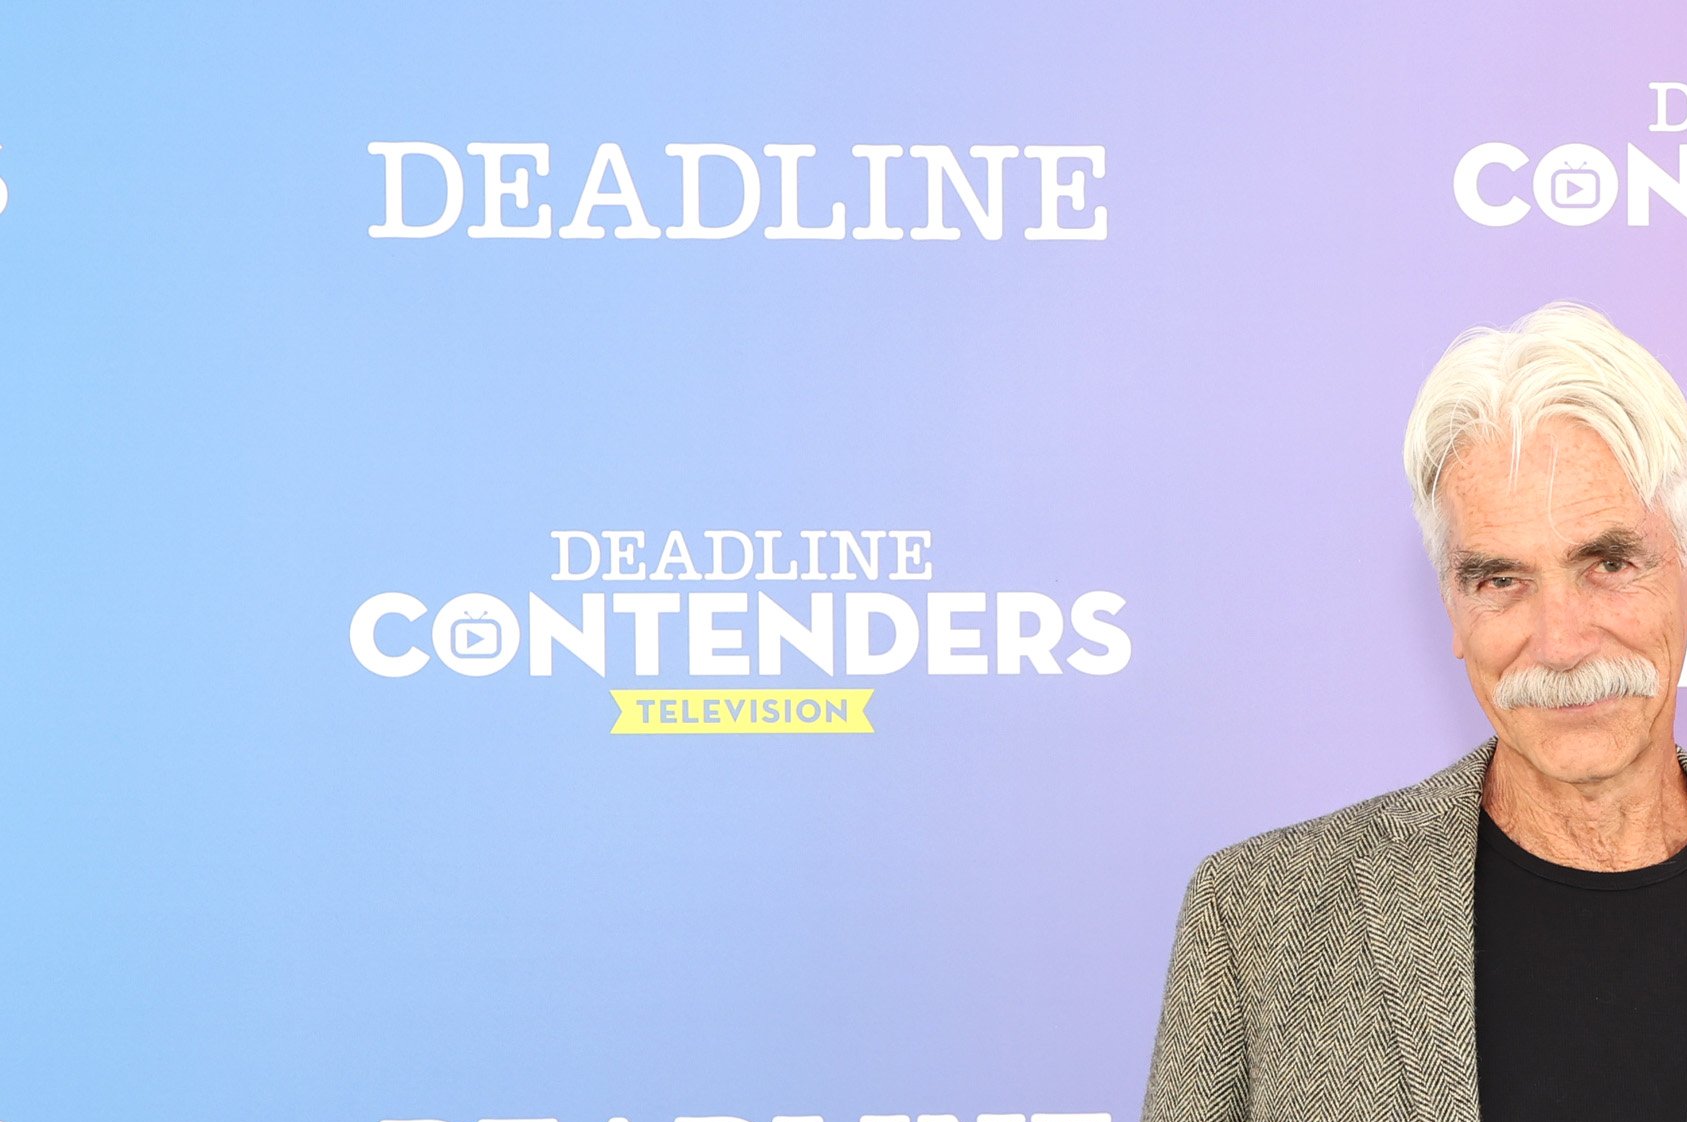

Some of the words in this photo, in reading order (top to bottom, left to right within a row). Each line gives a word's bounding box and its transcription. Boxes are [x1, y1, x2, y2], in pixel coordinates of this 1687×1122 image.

[368, 141, 1108, 241] DEADLINE
[550, 530, 933, 581] DEADLINE
[349, 590, 1132, 678] CONTENDERS
[635, 698, 849, 725] TELEVISION
